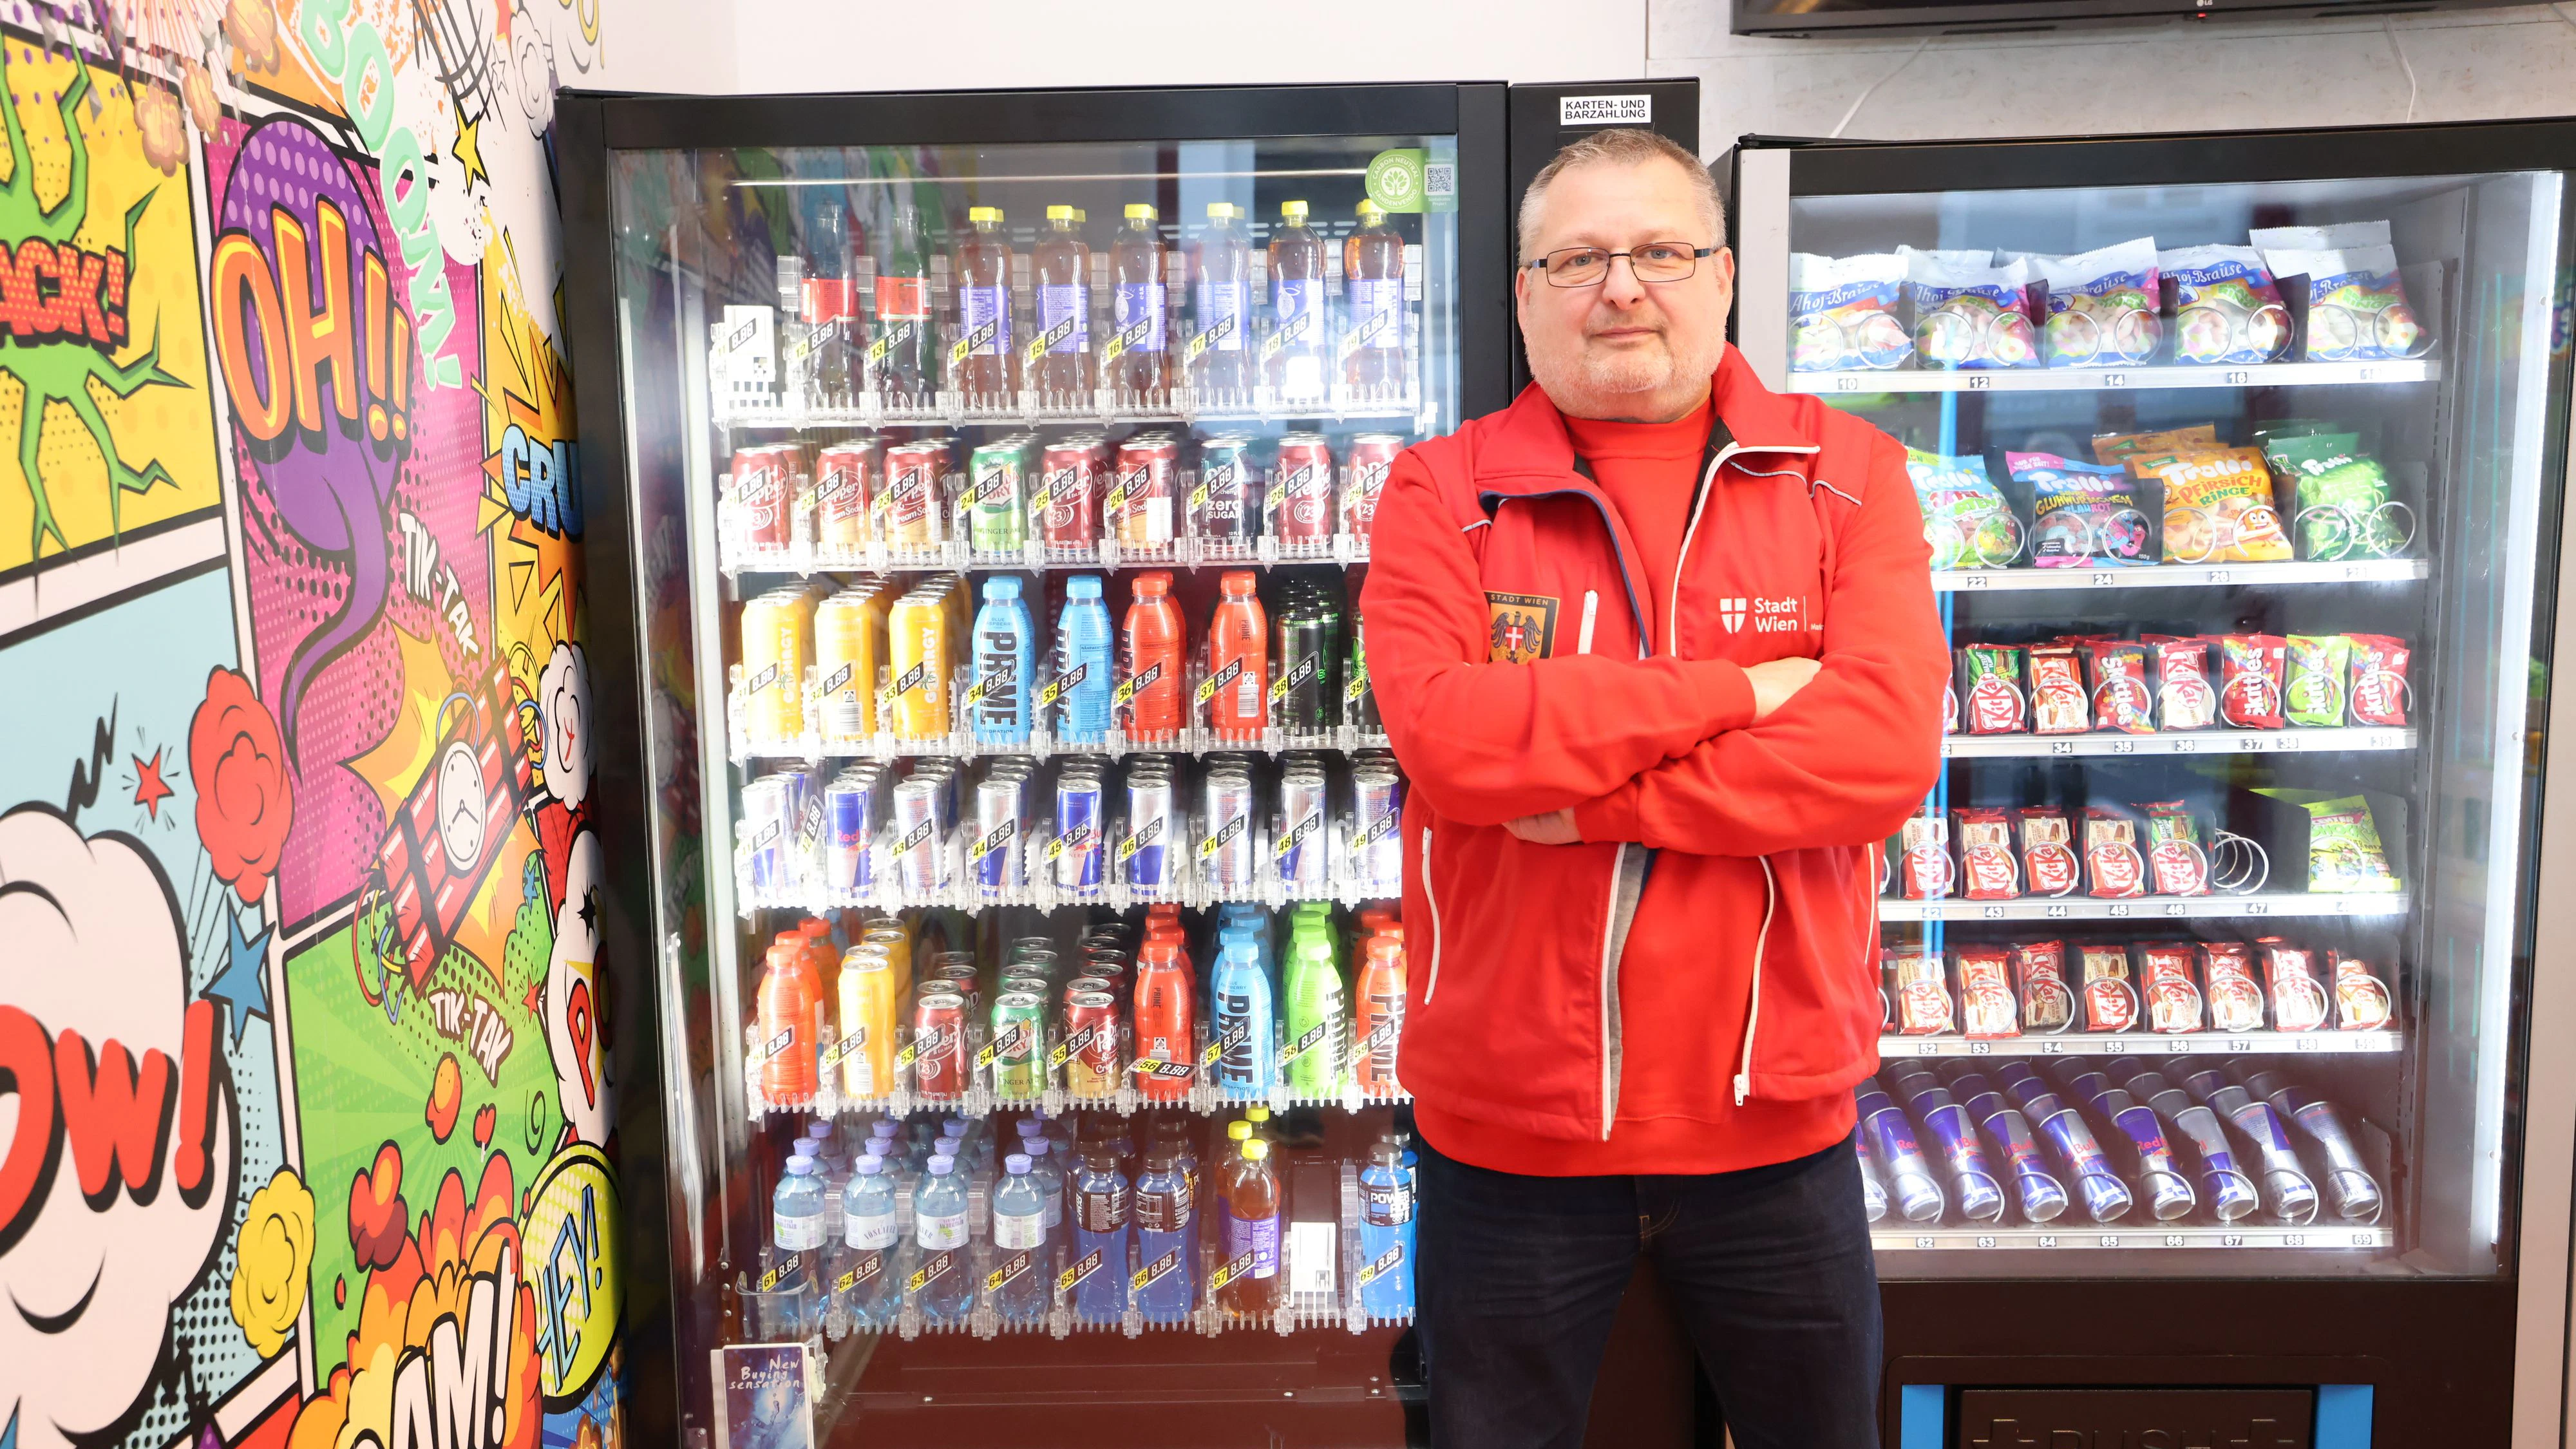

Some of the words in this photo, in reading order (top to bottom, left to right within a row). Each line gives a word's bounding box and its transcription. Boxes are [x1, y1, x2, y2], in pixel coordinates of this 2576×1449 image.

[1566, 100, 1617, 110] KARTEN-
[1621, 99, 1645, 109] UND
[1565, 109, 1646, 120] BARZAHLUNG
[1372, 157, 1394, 180] CARBON
[1395, 156, 1419, 178] NEUTRAL
[1374, 189, 1417, 207] SANDENVENDO
[210, 193, 413, 460] OH!!
[871, 340, 885, 357] 13
[888, 323, 911, 349] 8.88
[954, 343, 966, 357] 14
[972, 323, 994, 346] 8.88
[1031, 340, 1044, 357] 15
[1048, 321, 1070, 345] 8.88
[1108, 340, 1120, 356] 16
[1126, 321, 1148, 345] 8.88
[1192, 339, 1204, 354] 17
[1209, 319, 1231, 343] 8.88
[1973, 377, 1987, 387] 12
[2107, 376, 2123, 385] 14
[2229, 373, 2246, 383] 16
[2028, 471, 2114, 492] Trolli
[2159, 459, 2253, 485] Trolli
[876, 494, 889, 509] 23
[893, 473, 916, 497] 8.88
[960, 494, 974, 510] 24
[977, 475, 999, 498] 8.88
[1036, 492, 1049, 507] 25
[1052, 474, 1074, 497] 8.88
[1110, 491, 1123, 506] 26
[1126, 471, 1148, 495] 8.88
[1193, 489, 1205, 505] 27
[1209, 469, 1232, 493] 8.88
[1207, 500, 1242, 512] zero
[2090, 502, 2112, 512] ROT
[1969, 578, 1985, 587] 22
[2095, 575, 2112, 584] 24
[2211, 573, 2228, 582] 26
[1491, 594, 1520, 603] STADT
[1524, 597, 1548, 605] WIEN
[1754, 596, 1797, 613] Stadt
[1241, 620, 1250, 641] PRIME
[1755, 616, 1797, 632] Wien
[900, 667, 922, 689] 8.88
[969, 685, 982, 702] 34
[985, 668, 1008, 692] 8.88
[1044, 686, 1057, 701] 35
[1061, 667, 1084, 690] 8.88
[1118, 685, 1131, 699] 36
[1135, 667, 1159, 689] 8.88
[1200, 683, 1214, 698] 37
[1217, 663, 1240, 686] 8.88
[1274, 681, 1287, 696] 38
[1291, 661, 1312, 685] 8.88
[2054, 743, 2071, 753] 34
[2115, 743, 2132, 752] 35
[2177, 741, 2194, 750] 36
[2245, 740, 2262, 749] 37
[893, 842, 905, 857] 43
[909, 822, 929, 846] 8.88
[973, 842, 987, 857] 44
[989, 822, 1011, 847] 8.88
[1122, 840, 1135, 855] 46
[1139, 820, 1160, 844] 8.88
[1204, 838, 1216, 853] 47
[1220, 818, 1242, 841] 8.88
[1986, 907, 2002, 917] 43
[2049, 907, 2065, 916] 44
[2110, 906, 2127, 915] 45
[2167, 905, 2184, 914] 46
[2249, 904, 2266, 913] 47
[428, 989, 513, 1084] TIK-TAK
[842, 1032, 862, 1054] 8.88
[902, 1048, 914, 1061] 53
[917, 1031, 939, 1054] 8.88
[980, 1047, 993, 1061] 54
[997, 1031, 1017, 1053] 8.88
[1053, 1047, 1065, 1061] 55
[1070, 1028, 1090, 1051] 8.88
[1207, 1046, 1220, 1061] 57
[1224, 1026, 1244, 1050] 8.88
[1283, 1045, 1296, 1060] 58
[1301, 1027, 1322, 1048] 8.88
[2171, 1041, 2188, 1050] 56
[2232, 1041, 2248, 1050] 57
[1920, 1043, 1937, 1054] 52
[1973, 1043, 1989, 1053] 53
[2044, 1043, 2061, 1052] 54
[2107, 1043, 2123, 1052] 55
[1139, 1061, 1157, 1070] 56
[1160, 1063, 1189, 1077] 8.88
[1917, 1238, 1933, 1247] 62
[1978, 1238, 1994, 1247] 63
[2040, 1237, 2055, 1246] 64
[2101, 1236, 2117, 1245] 65
[2166, 1236, 2182, 1245] 66
[2225, 1236, 2240, 1245] 67
[2286, 1235, 2302, 1244] 68
[764, 1273, 774, 1287] 61
[779, 1255, 799, 1278] 8.88
[839, 1273, 853, 1288] 62
[857, 1257, 877, 1280] 8.88
[911, 1271, 924, 1287] 63
[928, 1255, 949, 1278] 8.88
[989, 1271, 1002, 1285] 64
[1006, 1255, 1026, 1277] 8.88
[1061, 1270, 1074, 1285] 65
[1078, 1255, 1098, 1275] 8.88
[1135, 1269, 1148, 1285] 66
[1151, 1255, 1171, 1276] 8.88
[1214, 1269, 1227, 1284] 67
[1231, 1254, 1251, 1275] 8.88
[1360, 1265, 1374, 1281] 69
[1378, 1249, 1399, 1271] 8.88
[769, 1354, 799, 1370] New
[741, 1366, 788, 1383] Buying
[729, 1379, 800, 1390] sensation
